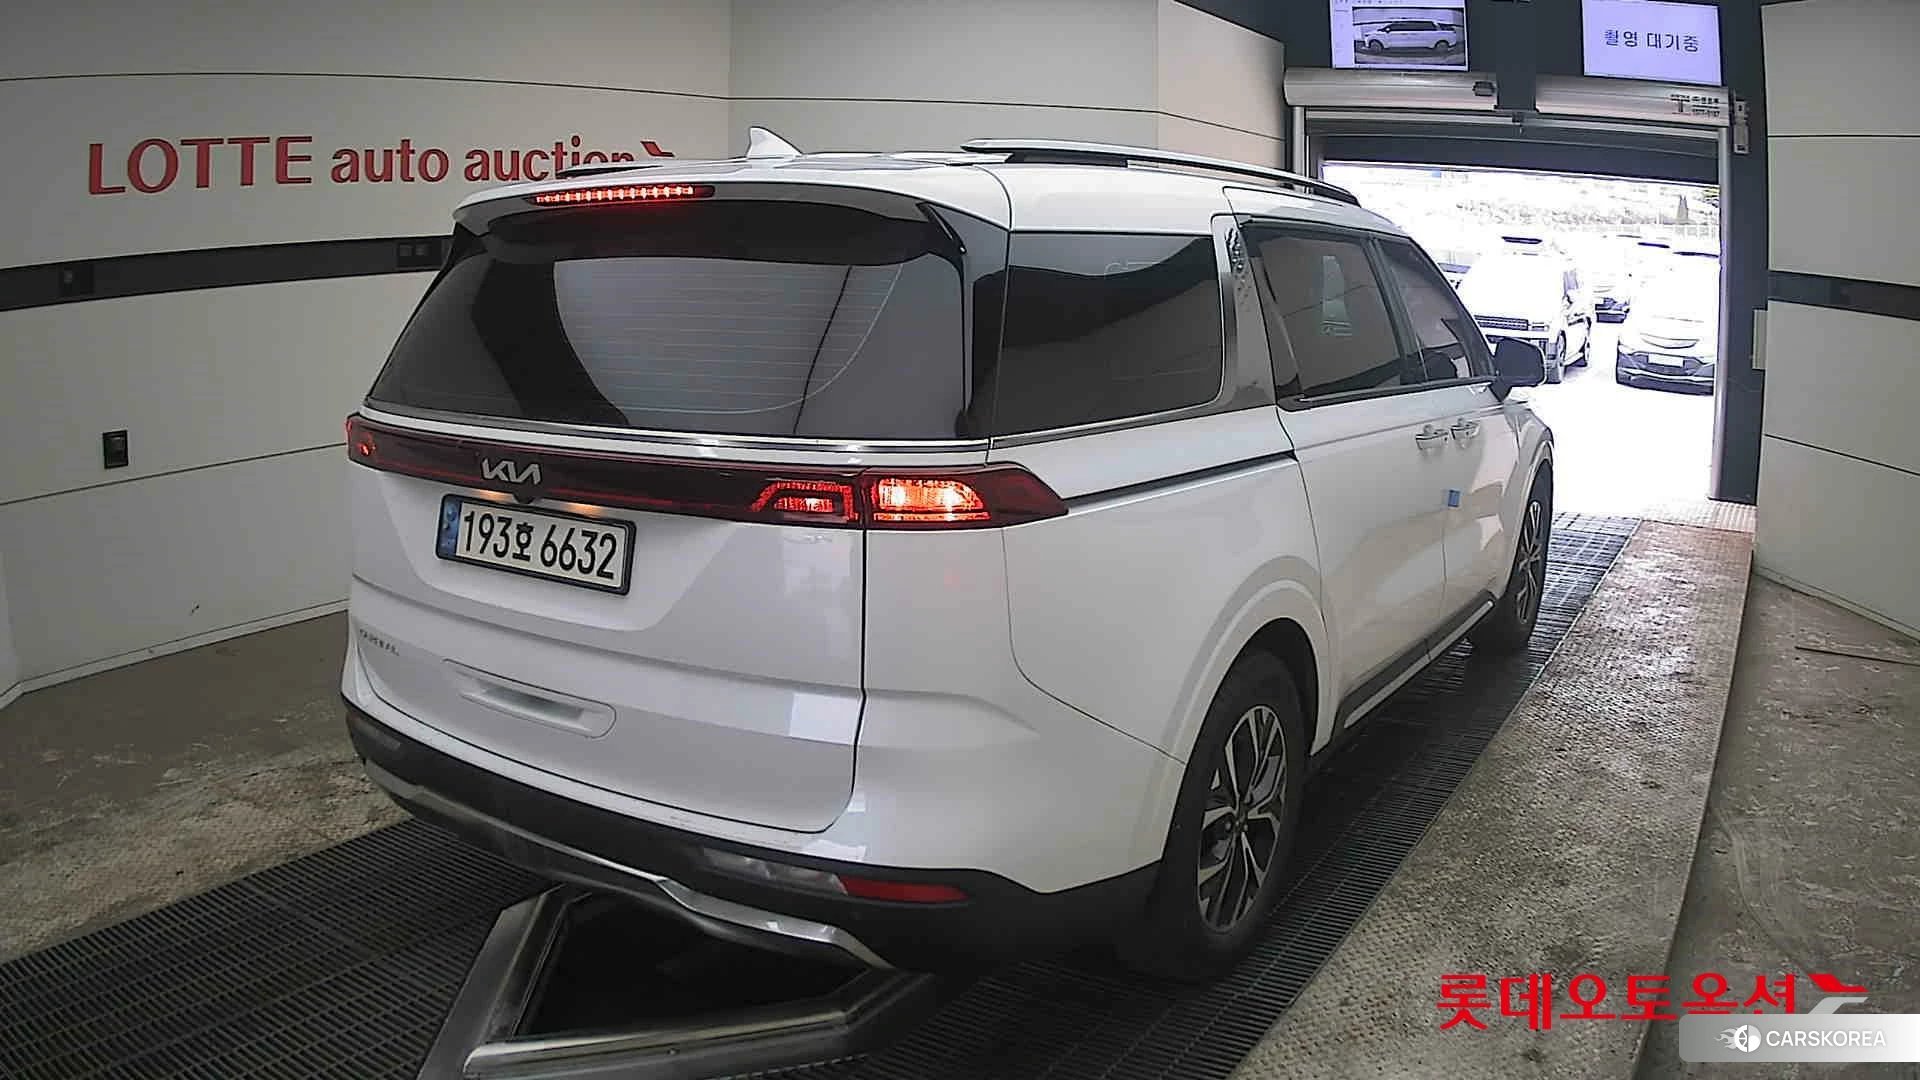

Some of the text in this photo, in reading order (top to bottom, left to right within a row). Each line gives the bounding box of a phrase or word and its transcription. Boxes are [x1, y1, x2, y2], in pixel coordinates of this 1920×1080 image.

[1646, 31, 1699, 53] 대기중
[88, 135, 313, 195] LOTTE
[330, 138, 449, 183] auto
[482, 458, 543, 485] KIA
[463, 510, 618, 580] 193호 6632
